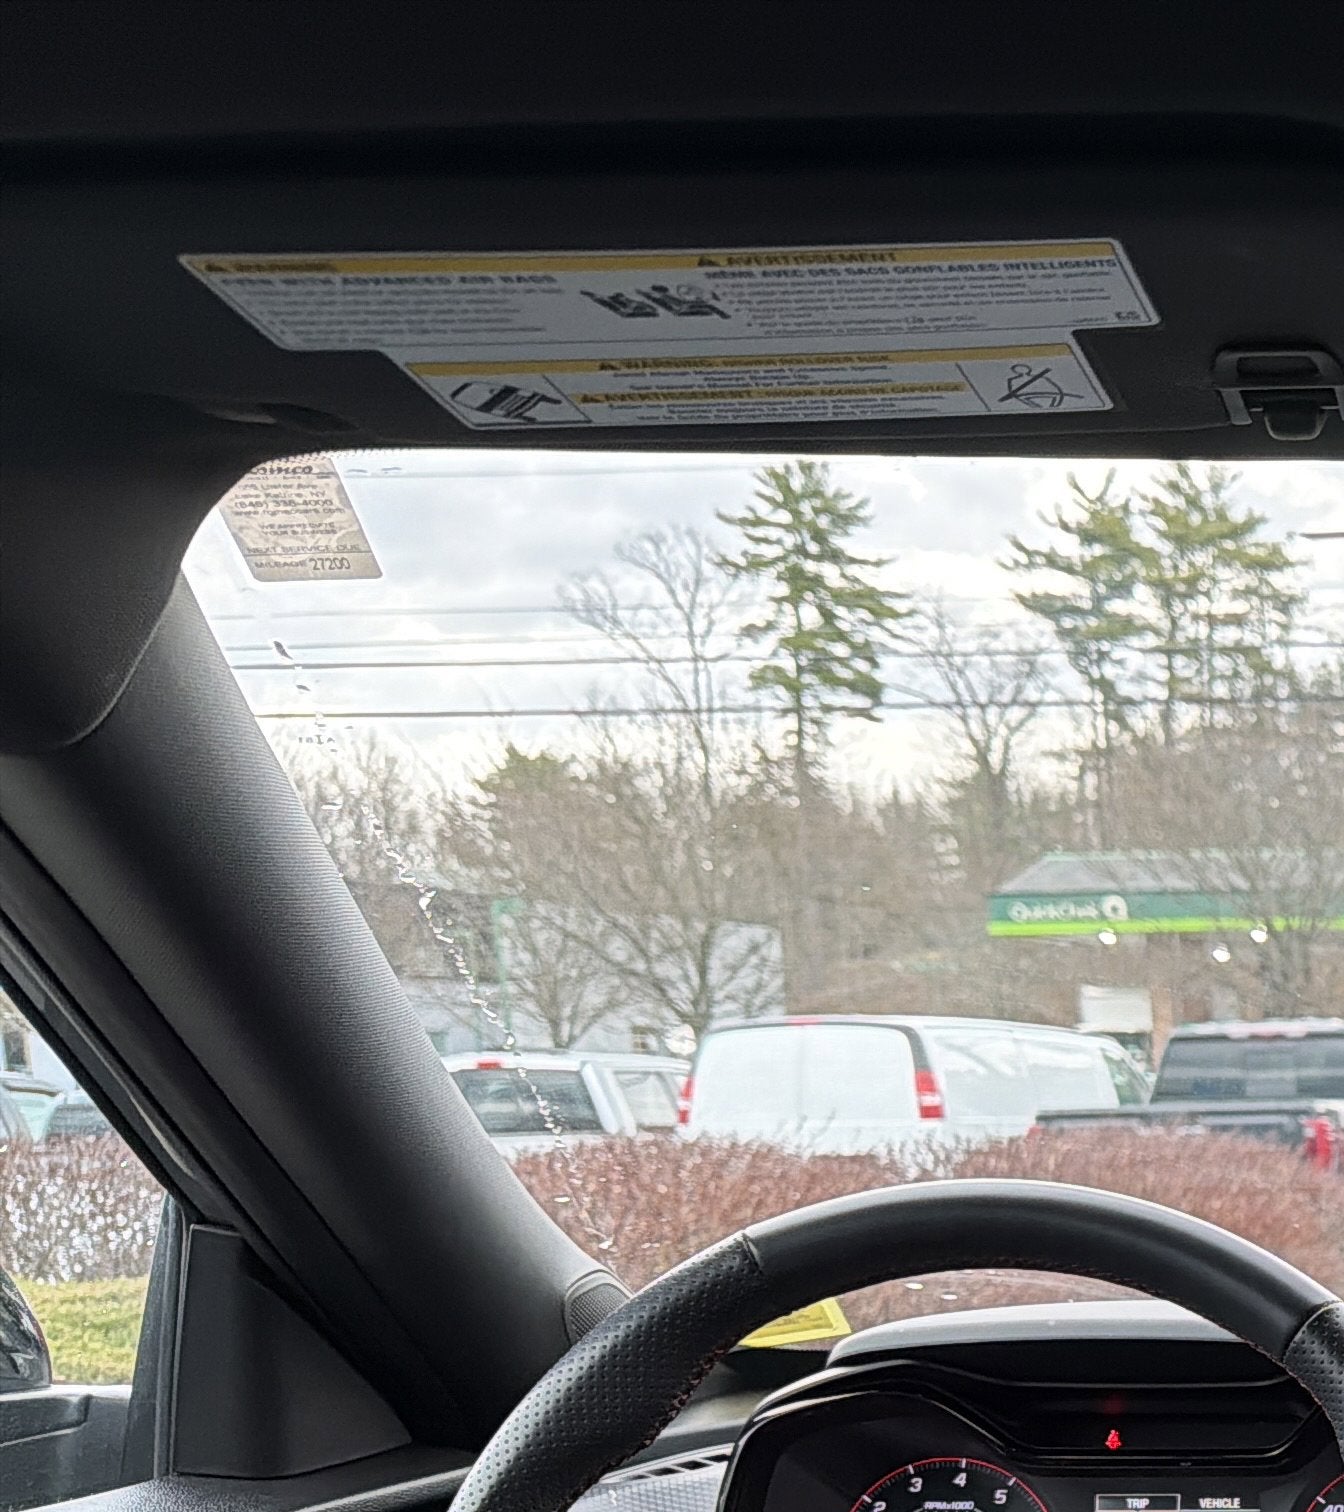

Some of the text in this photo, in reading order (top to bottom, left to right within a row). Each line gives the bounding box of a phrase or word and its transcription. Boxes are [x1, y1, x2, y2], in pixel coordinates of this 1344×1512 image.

[807, 266, 843, 277] DES
[1003, 258, 1118, 272] INTELLIGENTS
[282, 544, 331, 553] SERVICE
[309, 556, 352, 571] 27200
[909, 1476, 923, 1493] 3
[953, 1472, 968, 1488] 4
[993, 1488, 1009, 1505] 5
[1126, 1497, 1242, 1509] TRIP VEHICLE
[923, 1500, 975, 1511] RPMx1000
